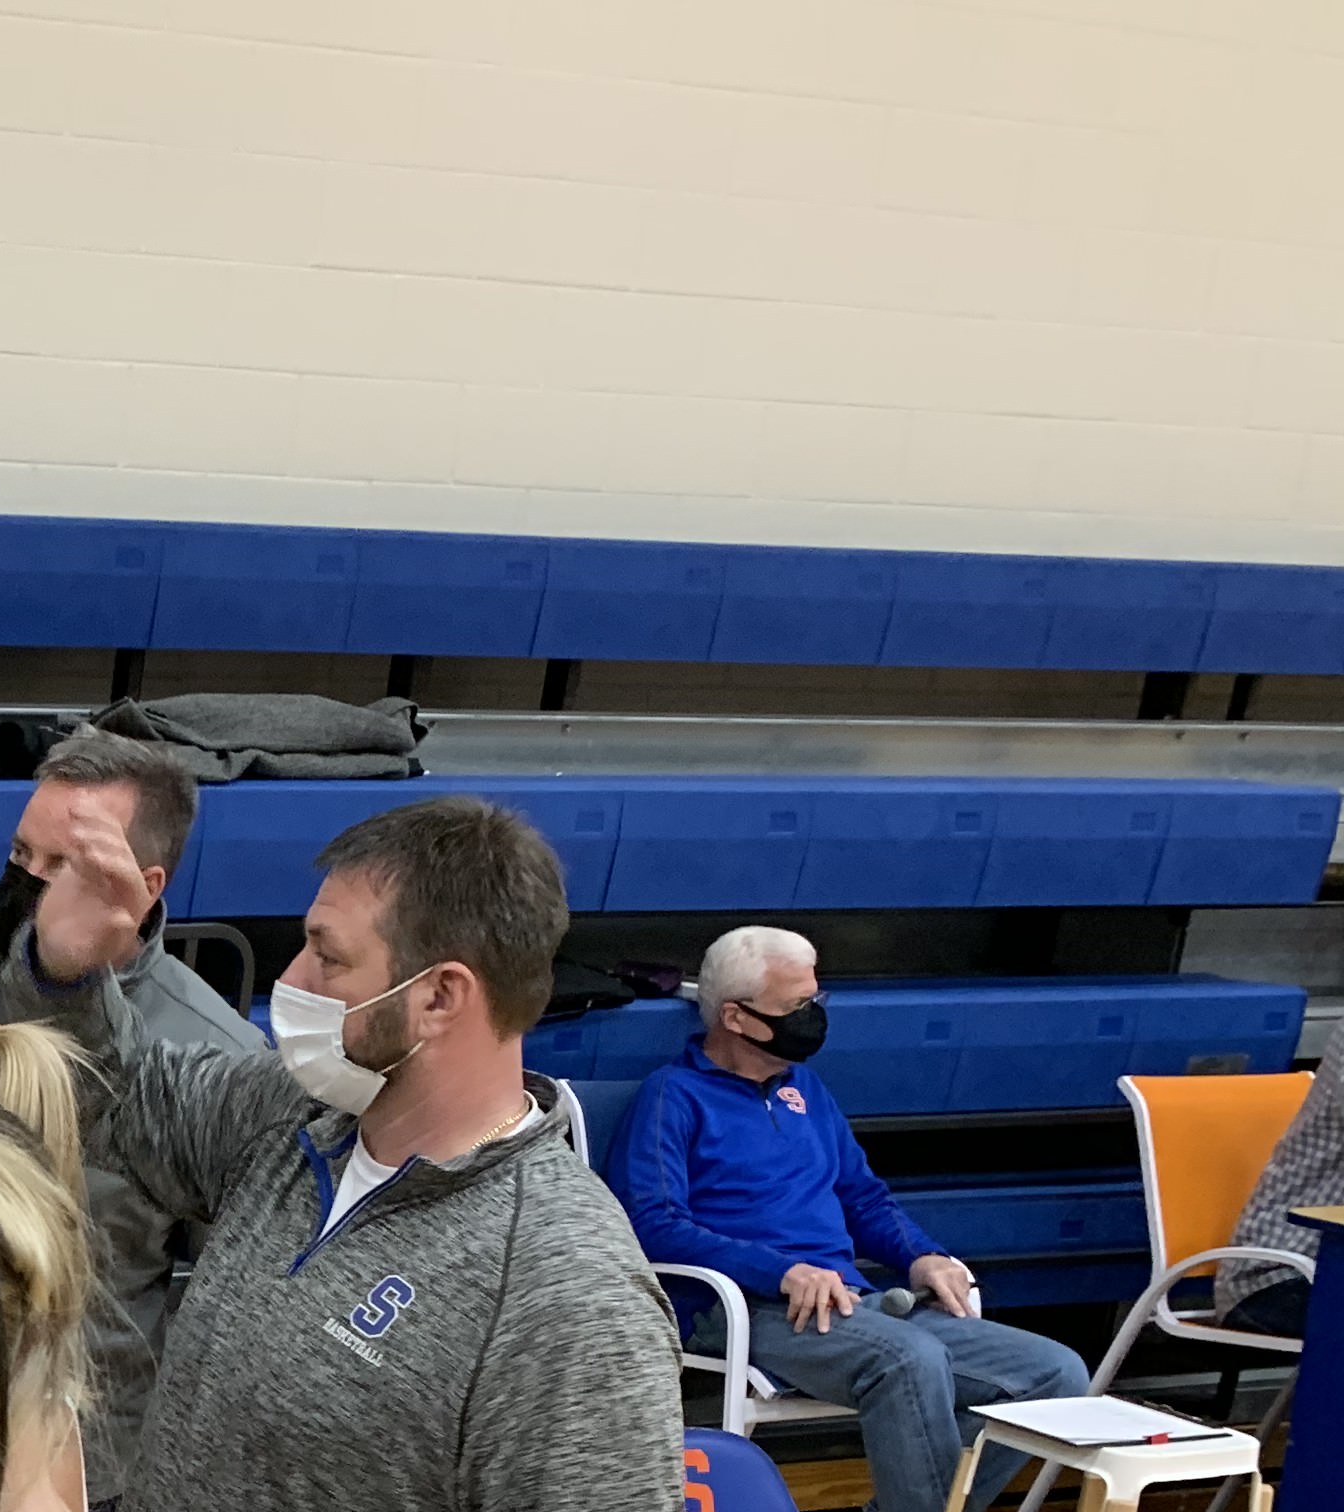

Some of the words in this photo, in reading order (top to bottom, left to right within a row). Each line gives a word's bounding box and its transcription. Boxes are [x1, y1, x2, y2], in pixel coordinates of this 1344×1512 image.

[776, 1086, 807, 1115] S
[350, 1275, 416, 1338] S
[322, 1317, 383, 1367] BASKETBALL
